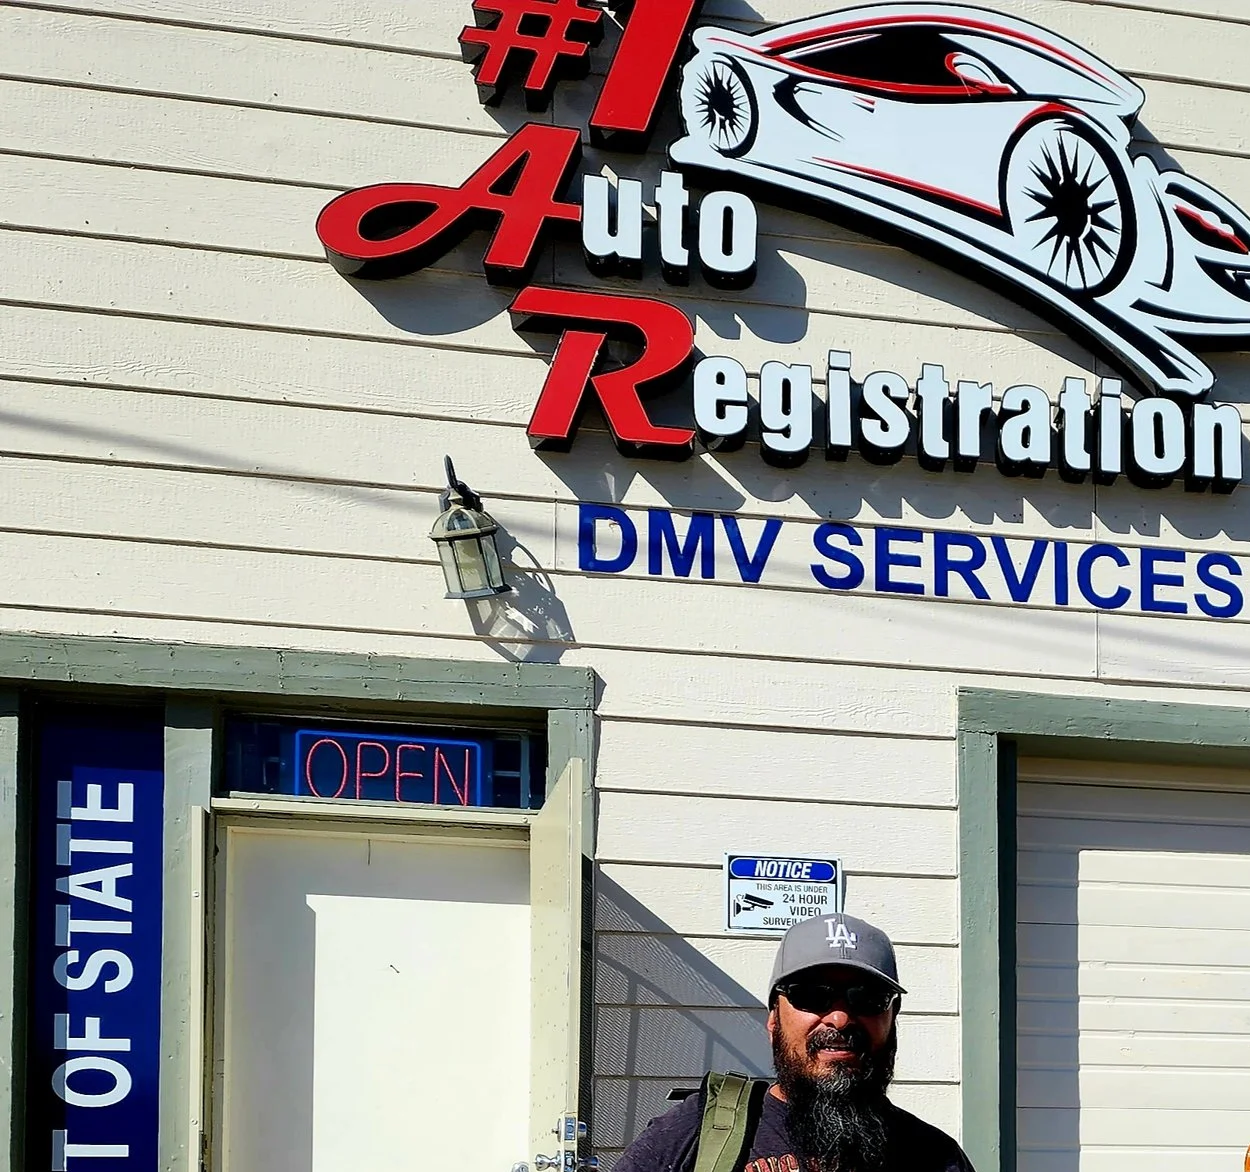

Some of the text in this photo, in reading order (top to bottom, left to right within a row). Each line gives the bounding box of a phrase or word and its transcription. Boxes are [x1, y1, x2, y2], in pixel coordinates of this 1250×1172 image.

[458, 0, 696, 132] #1
[315, 122, 758, 274] Auto
[510, 287, 1243, 481] Registration
[577, 502, 1244, 619] DMV SERVICES
[306, 738, 469, 806] OPEN
[53, 780, 134, 993] STATE
[754, 860, 812, 879] NOTICE
[756, 883, 828, 893] THIS AREA IS UNDER
[782, 893, 828, 905] 24 HOUR
[789, 905, 821, 917] VIDEO
[824, 918, 858, 949] LA
[51, 1013, 133, 1107] OF
